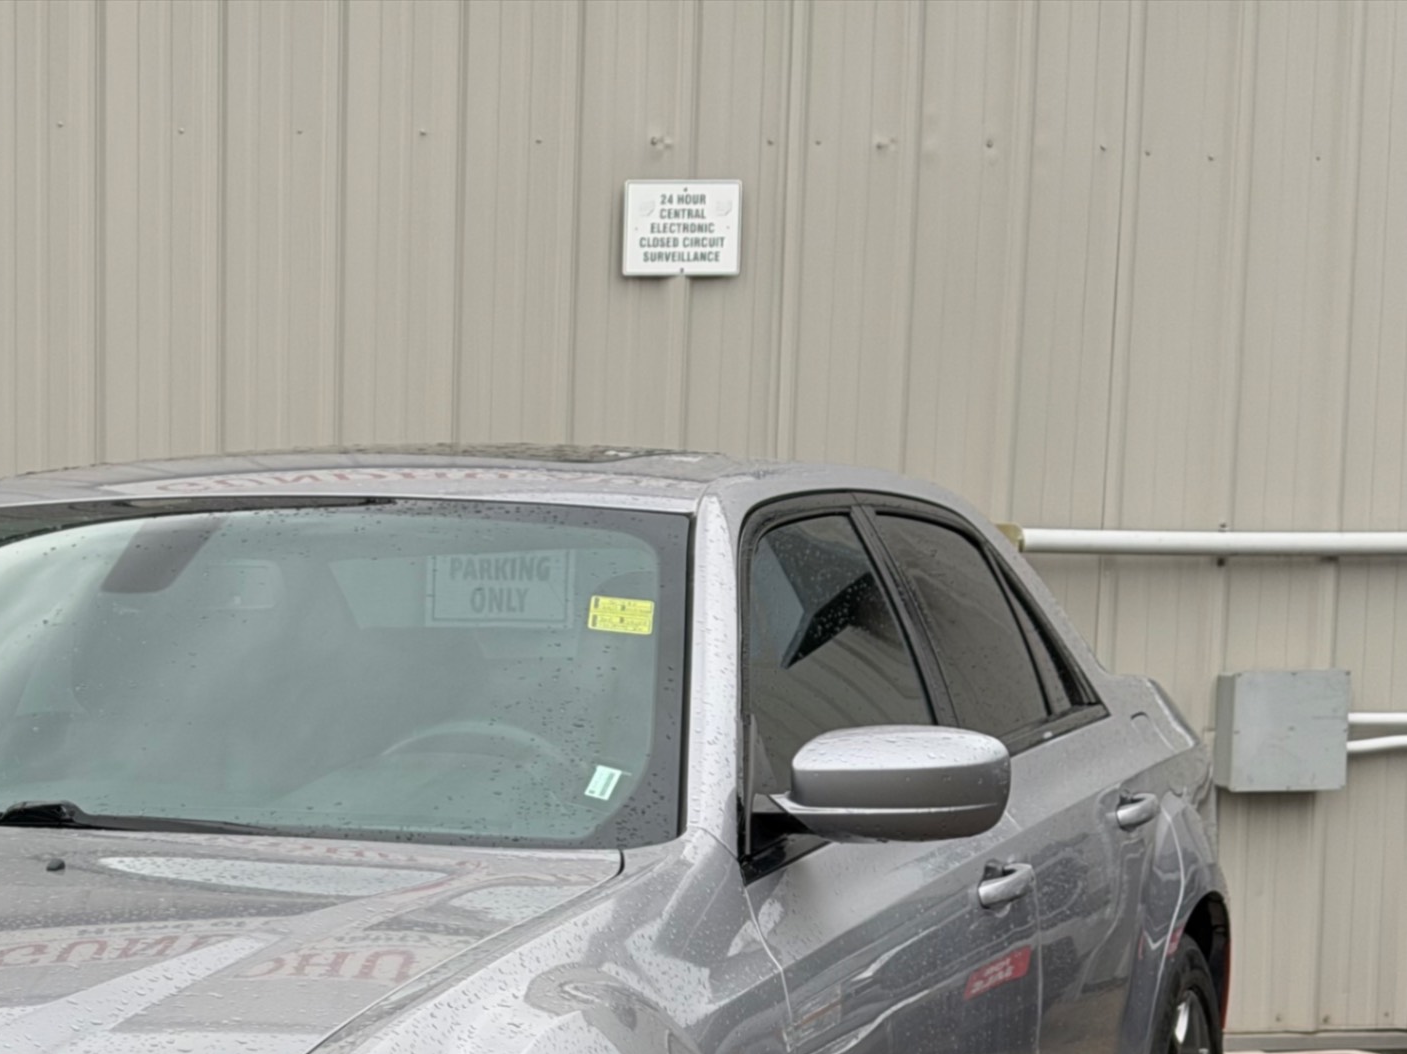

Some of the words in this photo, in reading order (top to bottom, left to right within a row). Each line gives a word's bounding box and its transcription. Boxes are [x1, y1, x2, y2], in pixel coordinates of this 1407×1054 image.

[660, 194, 673, 205] 24
[677, 194, 706, 205] HOUR
[659, 208, 706, 219] CENTRAL
[650, 222, 715, 234] ELECTRONIC
[639, 237, 679, 248] CLOSED
[682, 237, 725, 248] CIRCUIT
[643, 251, 720, 262] SURVEILLANCE
[449, 556, 551, 581] PARKING
[470, 585, 530, 613] ONLY
